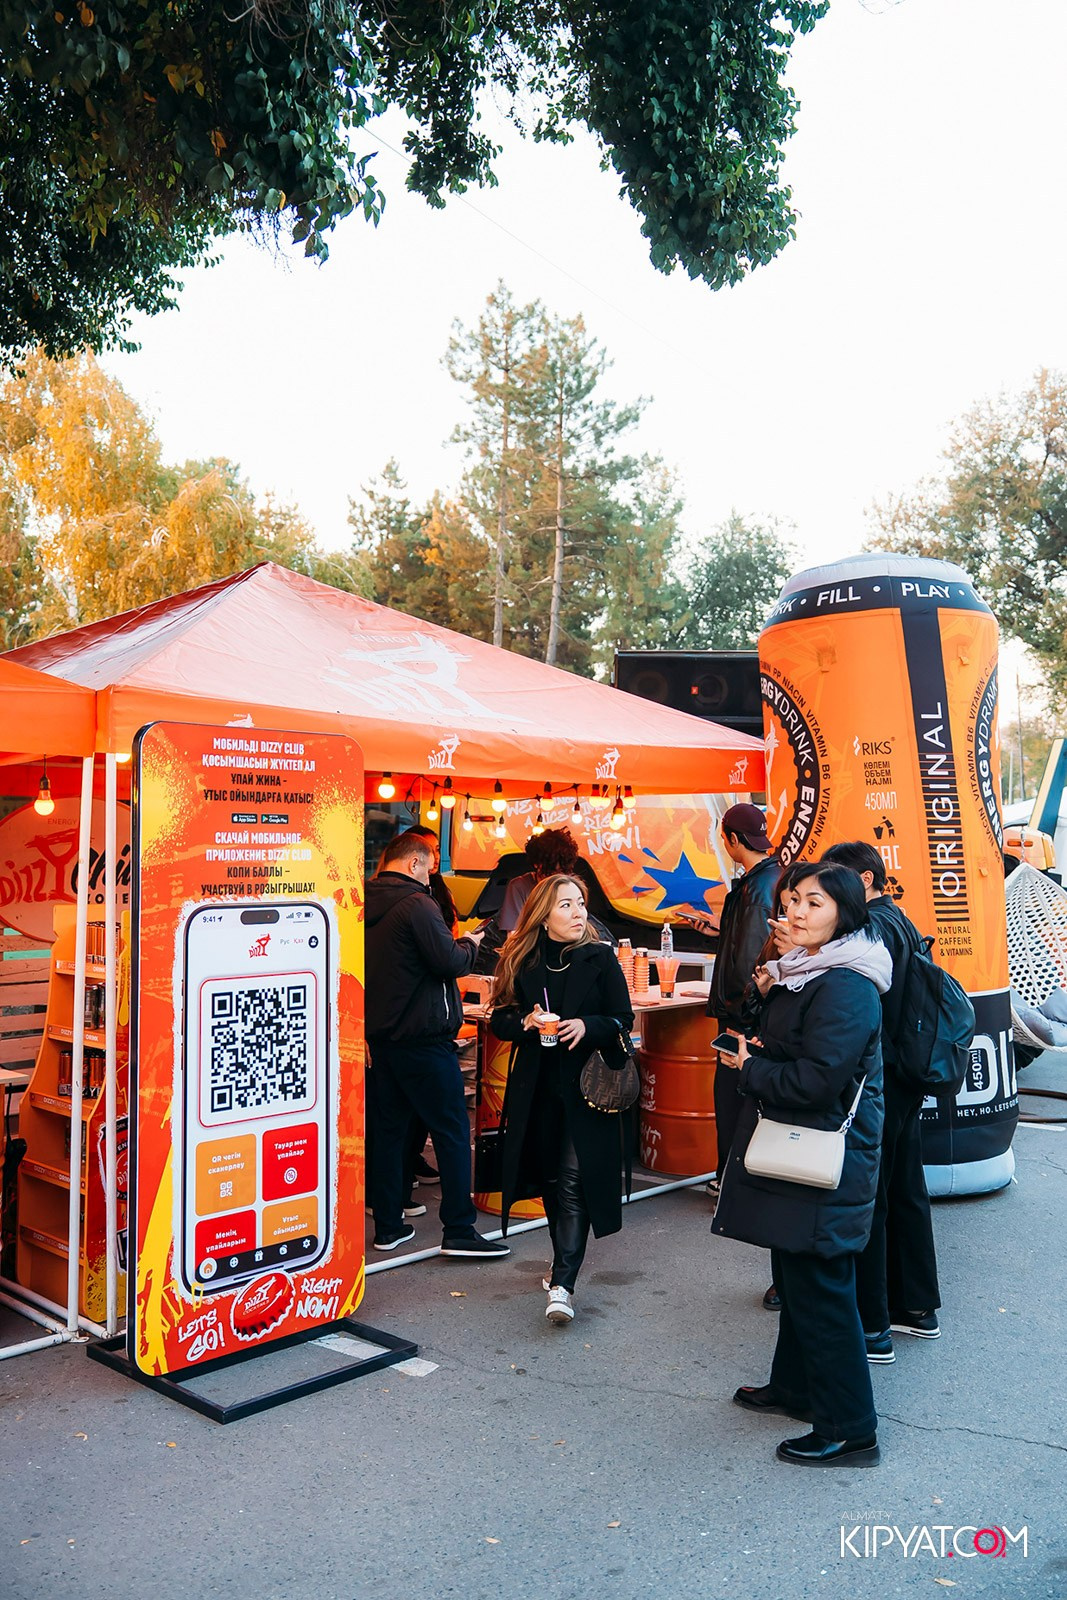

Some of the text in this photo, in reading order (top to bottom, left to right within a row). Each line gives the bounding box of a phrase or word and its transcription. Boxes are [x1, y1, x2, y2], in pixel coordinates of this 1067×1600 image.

[817, 586, 861, 606] FILL
[901, 582, 950, 599] PLAY
[782, 677, 806, 708] NIACIN
[806, 709, 828, 757] VITAMIN
[213, 738, 304, 755] МОБИЛЬДІ DIZZY CLUB
[862, 741, 892, 756] RIKS
[202, 754, 268, 769] ҚОСЫМШАСЫН
[304, 760, 315, 772] АЛ
[256, 775, 281, 786] ЖИНА
[822, 764, 831, 780] B6
[865, 769, 891, 778] ОБЪЕМ
[968, 750, 979, 801] VITAMIN
[865, 777, 892, 786] HAJMI
[864, 791, 898, 811] 450МЛ
[921, 702, 960, 897] ORIGINAL
[583, 808, 637, 831] RIGT
[814, 787, 831, 837] VITAMIN
[780, 785, 815, 866] ENERG
[215, 830, 301, 844] СКАЧАЙ МОБИЛЬНОЕ
[586, 826, 641, 856] NOW!
[206, 849, 312, 861] ПРИЛОЖЕНИЕ DIZZY CLUB
[227, 866, 250, 878] КОПИ
[253, 866, 282, 877] БАЛЛЫ
[201, 882, 316, 896] УЧАСТВУЙ В РОЗЫГРЫШАХ!
[937, 926, 971, 935] NATURAL
[939, 937, 972, 945] CAFFEINE
[940, 948, 973, 956] & VITAMINS
[970, 1050, 984, 1090] 450ml
[957, 1108, 978, 1117] HEY,
[274, 1141, 293, 1150] Тауар
[212, 1156, 222, 1164] QR
[300, 1277, 343, 1295] RIGHT
[295, 1296, 340, 1319] NOW!
[186, 1322, 226, 1361] GO!
